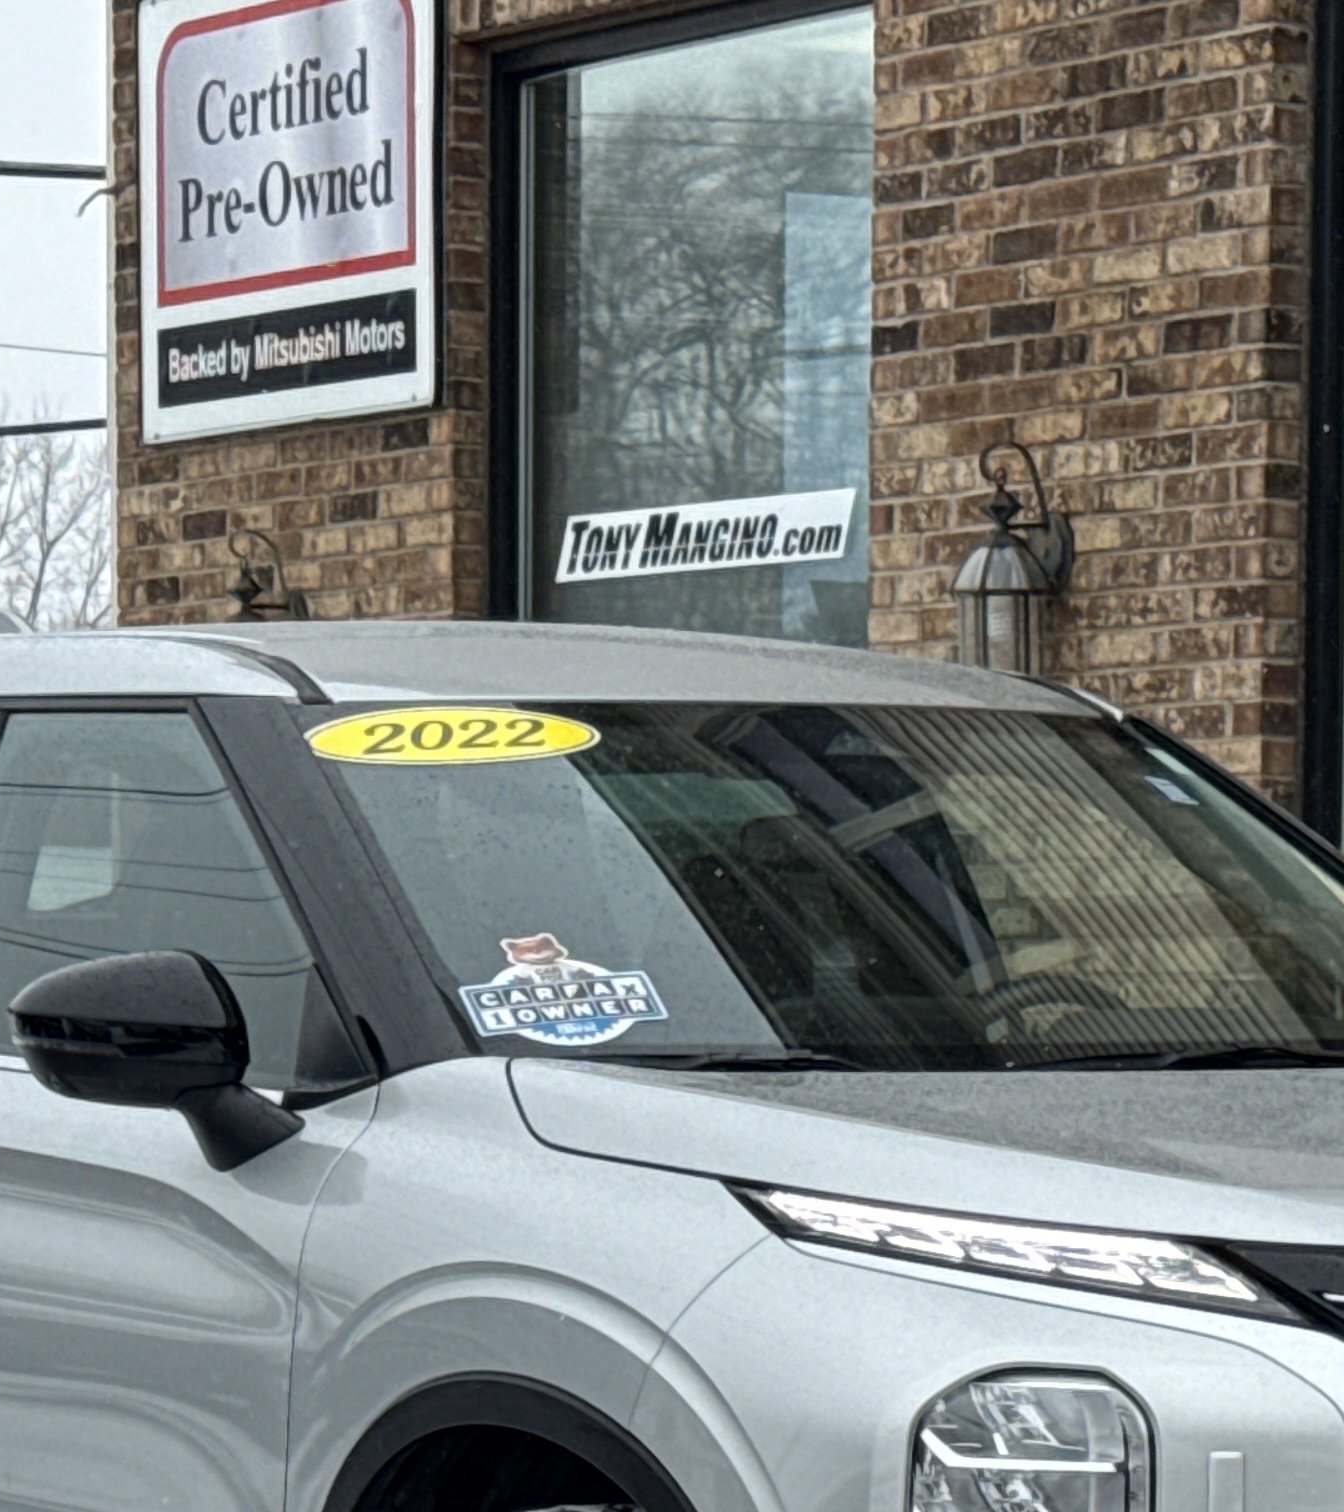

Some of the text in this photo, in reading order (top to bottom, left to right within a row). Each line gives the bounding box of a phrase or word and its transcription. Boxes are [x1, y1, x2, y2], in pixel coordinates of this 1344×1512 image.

[196, 46, 370, 146] Certified
[178, 138, 395, 243] Pre-Owned
[168, 317, 406, 383] Backed by Mitsubishi Motors
[362, 717, 547, 756] 2022
[479, 982, 642, 1007] CARFAX
[516, 998, 649, 1023] OWNER
